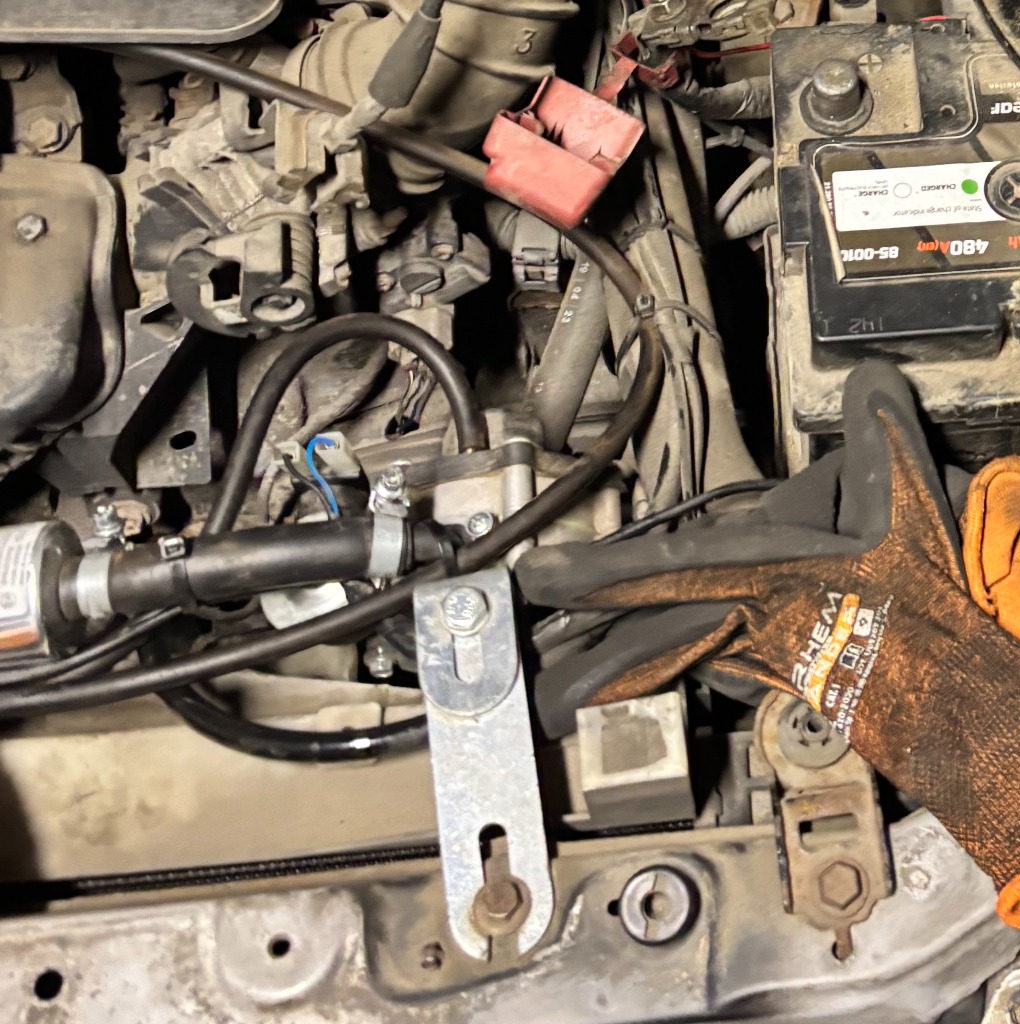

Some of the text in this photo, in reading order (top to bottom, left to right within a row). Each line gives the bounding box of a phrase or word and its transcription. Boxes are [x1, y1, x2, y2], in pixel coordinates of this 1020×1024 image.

[513, 27, 537, 55] 3
[921, 183, 957, 192] CHARGED
[858, 189, 889, 198] CHARGE
